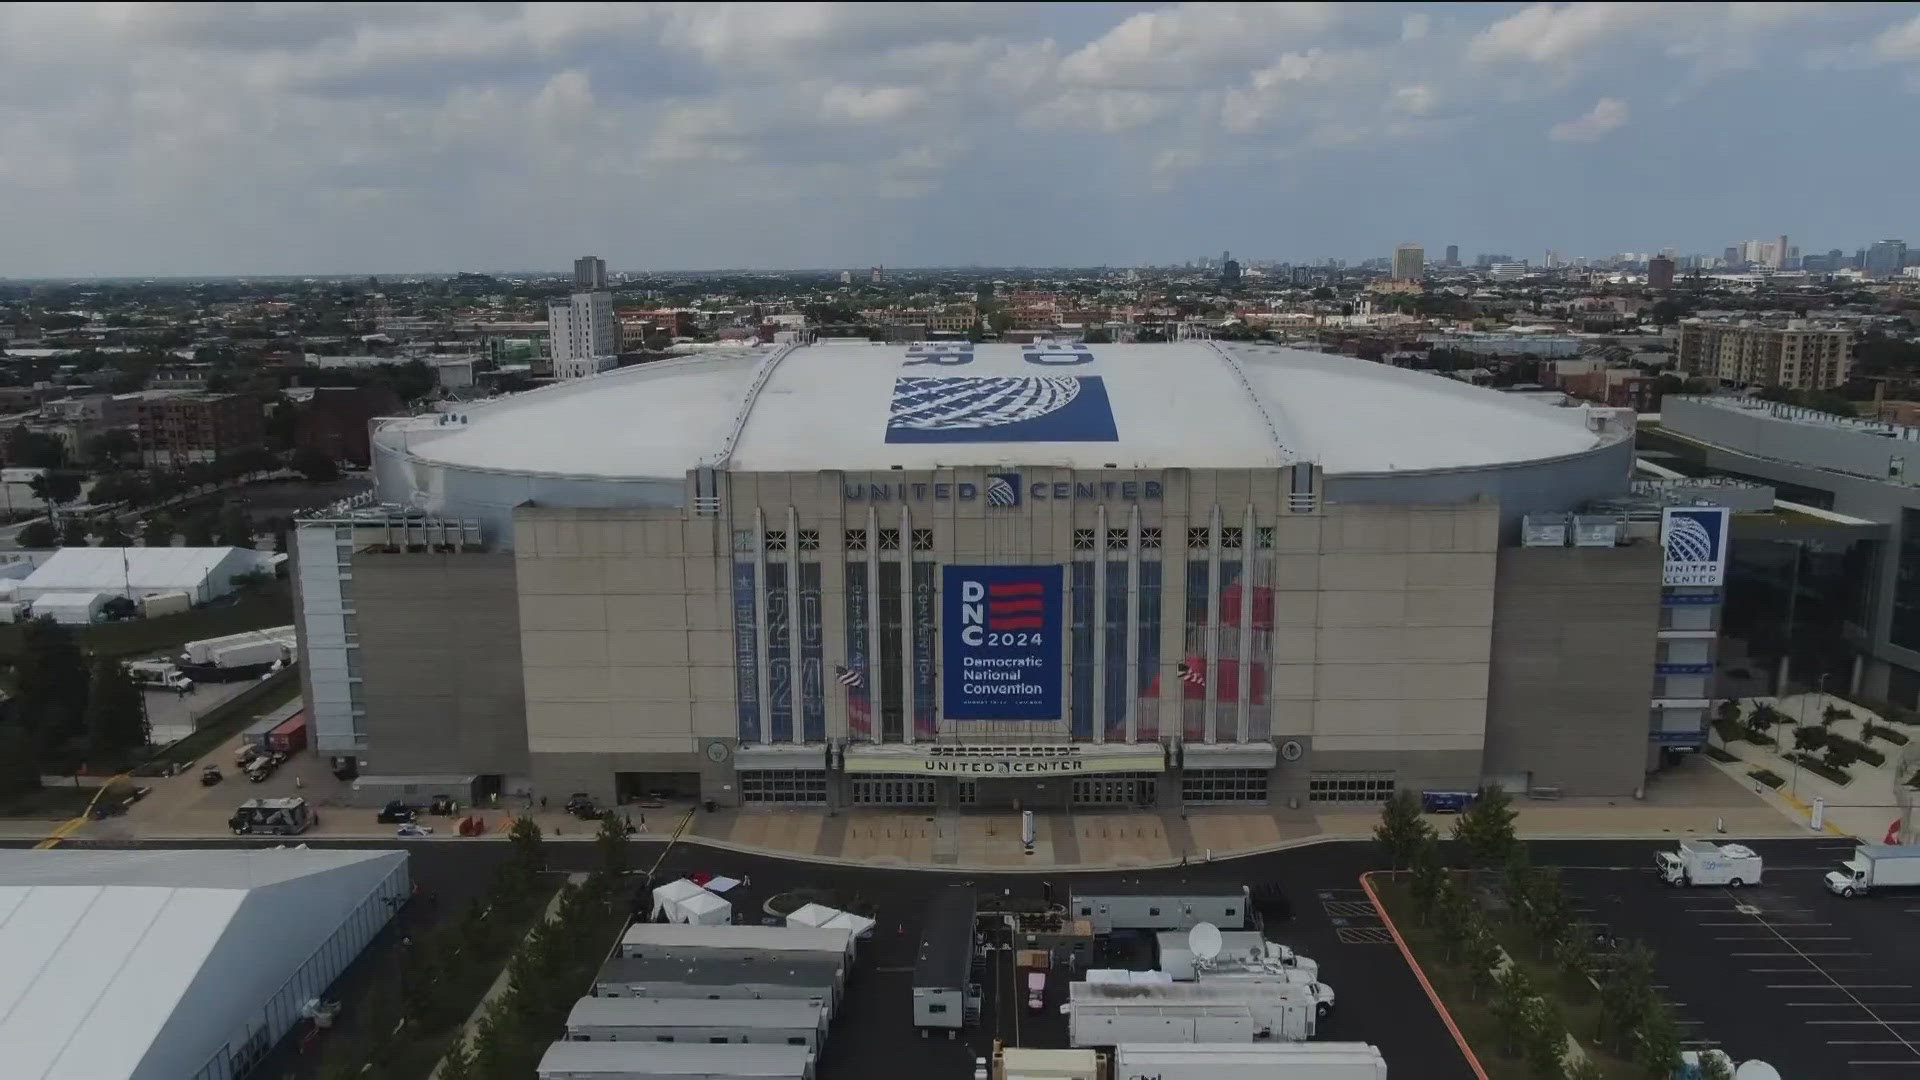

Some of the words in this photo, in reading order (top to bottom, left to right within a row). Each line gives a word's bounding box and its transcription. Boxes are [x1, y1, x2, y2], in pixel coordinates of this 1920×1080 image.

[845, 482, 977, 499] UNITED
[1030, 481, 1164, 500] CENTER
[1665, 565, 1717, 573] UNITED
[1664, 575, 1715, 584] CENTER
[918, 583, 930, 685] CONVENTION
[988, 632, 1043, 646] 2024
[963, 655, 1043, 667] Democratic
[963, 669, 1021, 680] National
[963, 683, 1043, 694] Convention
[925, 761, 994, 772] UNITED
[1014, 761, 1083, 772] CENTER
